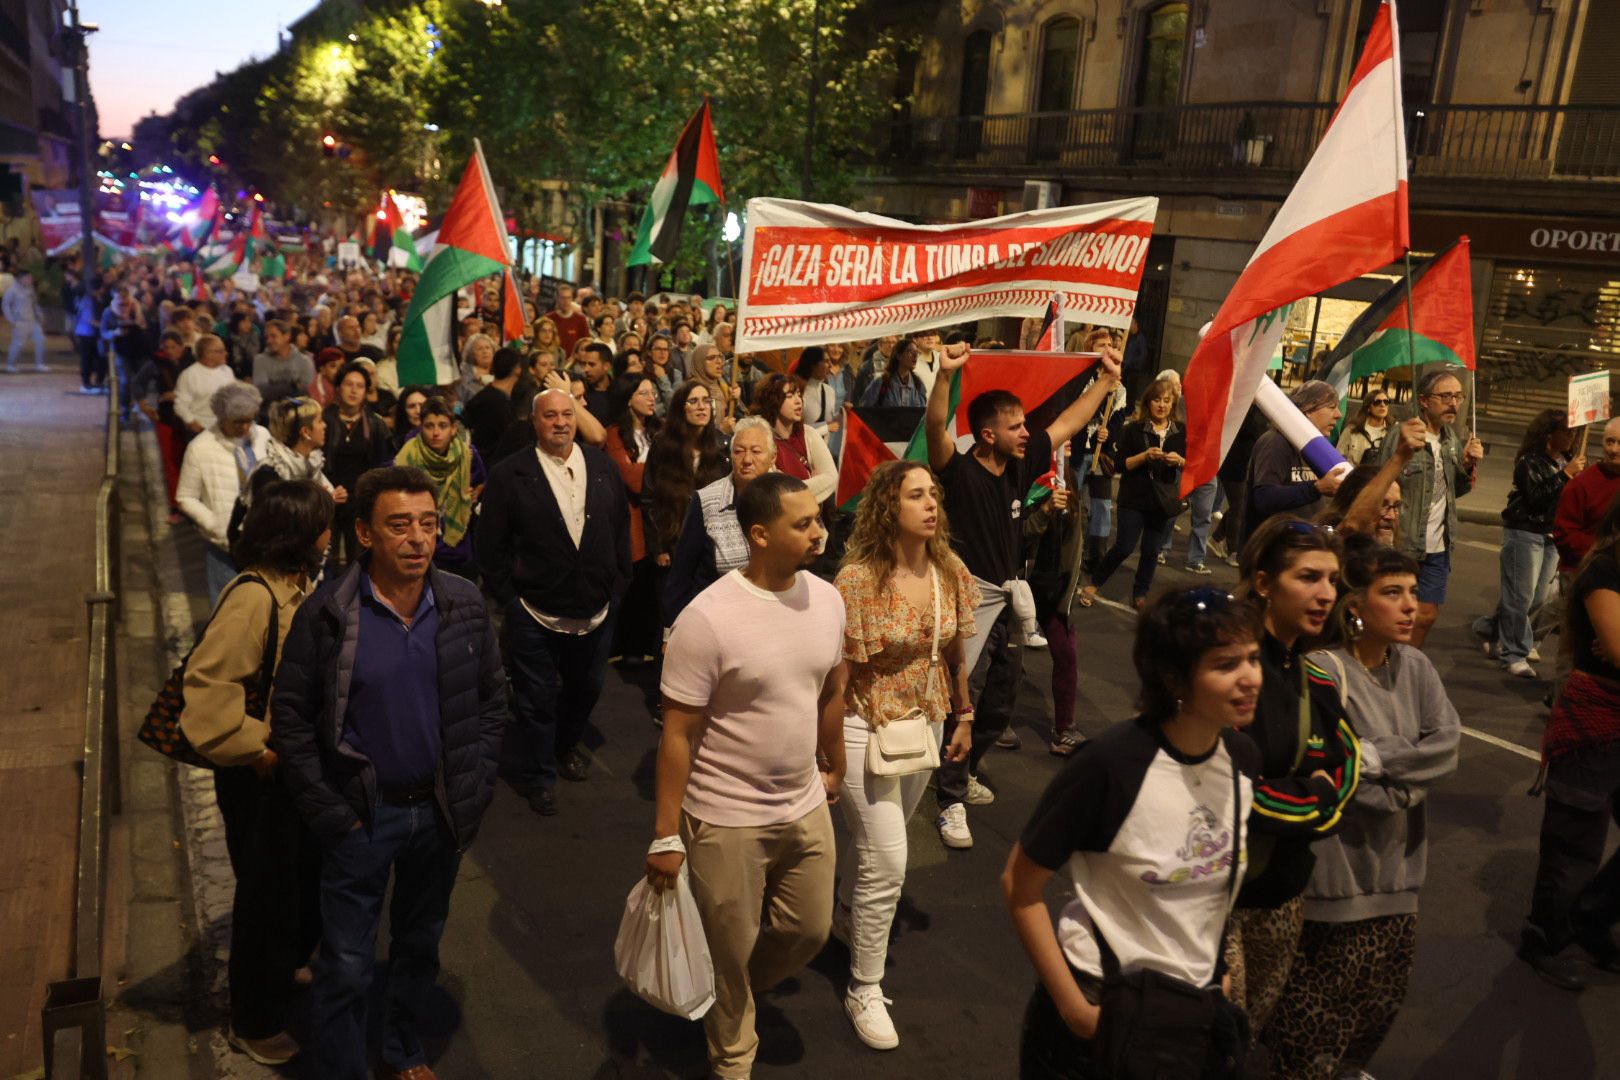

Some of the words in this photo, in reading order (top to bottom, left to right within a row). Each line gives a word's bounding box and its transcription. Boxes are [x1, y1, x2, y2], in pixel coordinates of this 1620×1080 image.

[752, 244, 822, 296] ¡GAZA
[826, 236, 883, 287] SERÁ
[889, 244, 919, 284] LA
[924, 244, 1000, 283] TUMBA
[1031, 231, 1150, 275] SIONISMO!
